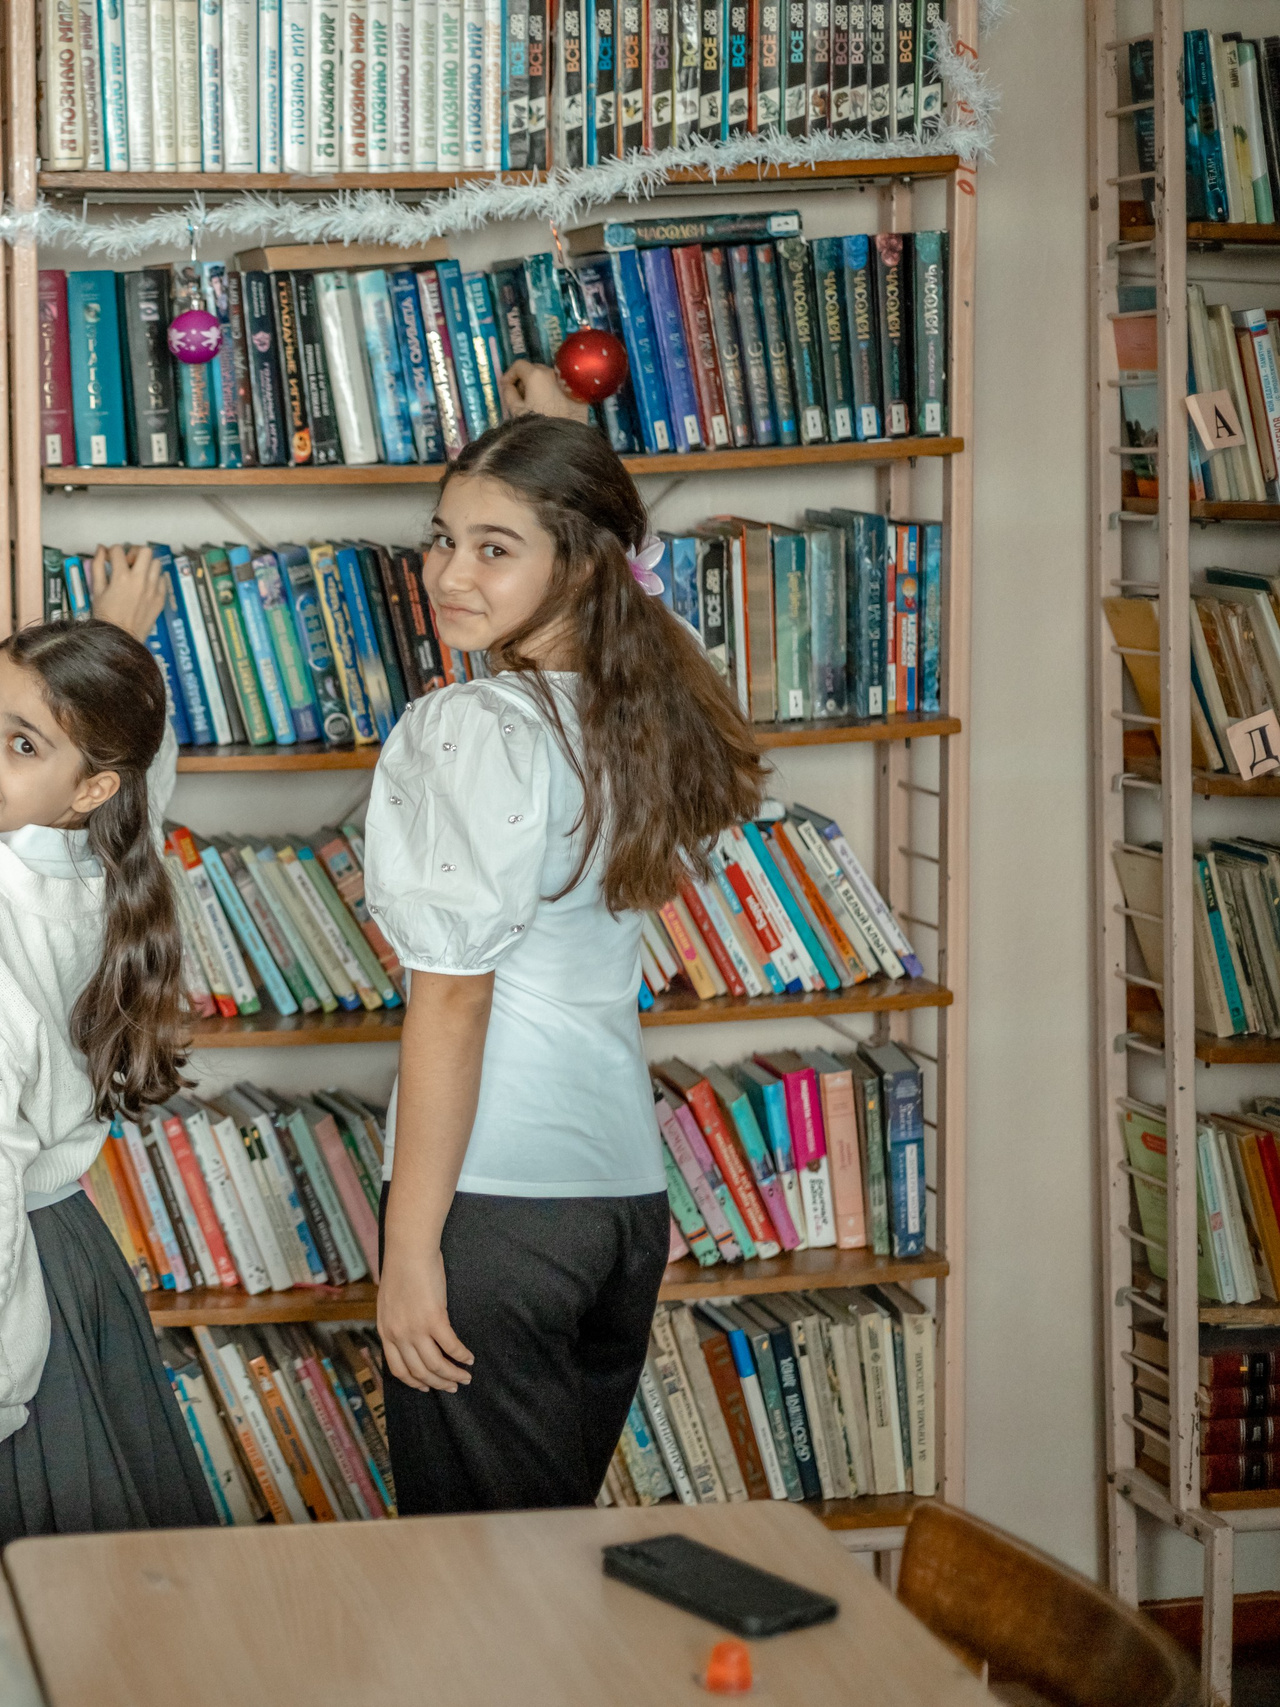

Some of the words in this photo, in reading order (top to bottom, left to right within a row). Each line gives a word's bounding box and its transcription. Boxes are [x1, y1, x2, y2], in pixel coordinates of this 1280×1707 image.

[58, 1, 73, 43] МИР
[291, 23, 304, 57] МИР
[320, 13, 334, 54] МИР
[350, 13, 366, 53] МИР
[467, 22, 481, 59] МИР
[60, 49, 75, 134] ПОЗНАЮ
[290, 63, 304, 128] ПОЗНАЮ
[318, 61, 334, 138] ПОЗНАЮ
[350, 60, 366, 138] ПОЗНАЮ
[467, 64, 481, 135] ПОЗНАЮ
[61, 140, 76, 151] Я
[290, 134, 304, 145] Я
[317, 143, 335, 157] Я
[352, 143, 366, 157] Я
[466, 140, 481, 153] Я
[278, 281, 296, 373] ГОЛОДНЫЕ
[290, 378, 302, 426] ИГРЫ
[1214, 404, 1237, 438] А
[1245, 723, 1280, 777] Д
[842, 889, 869, 924] БЕЛЫЙ
[863, 924, 888, 955] КЛЫК
